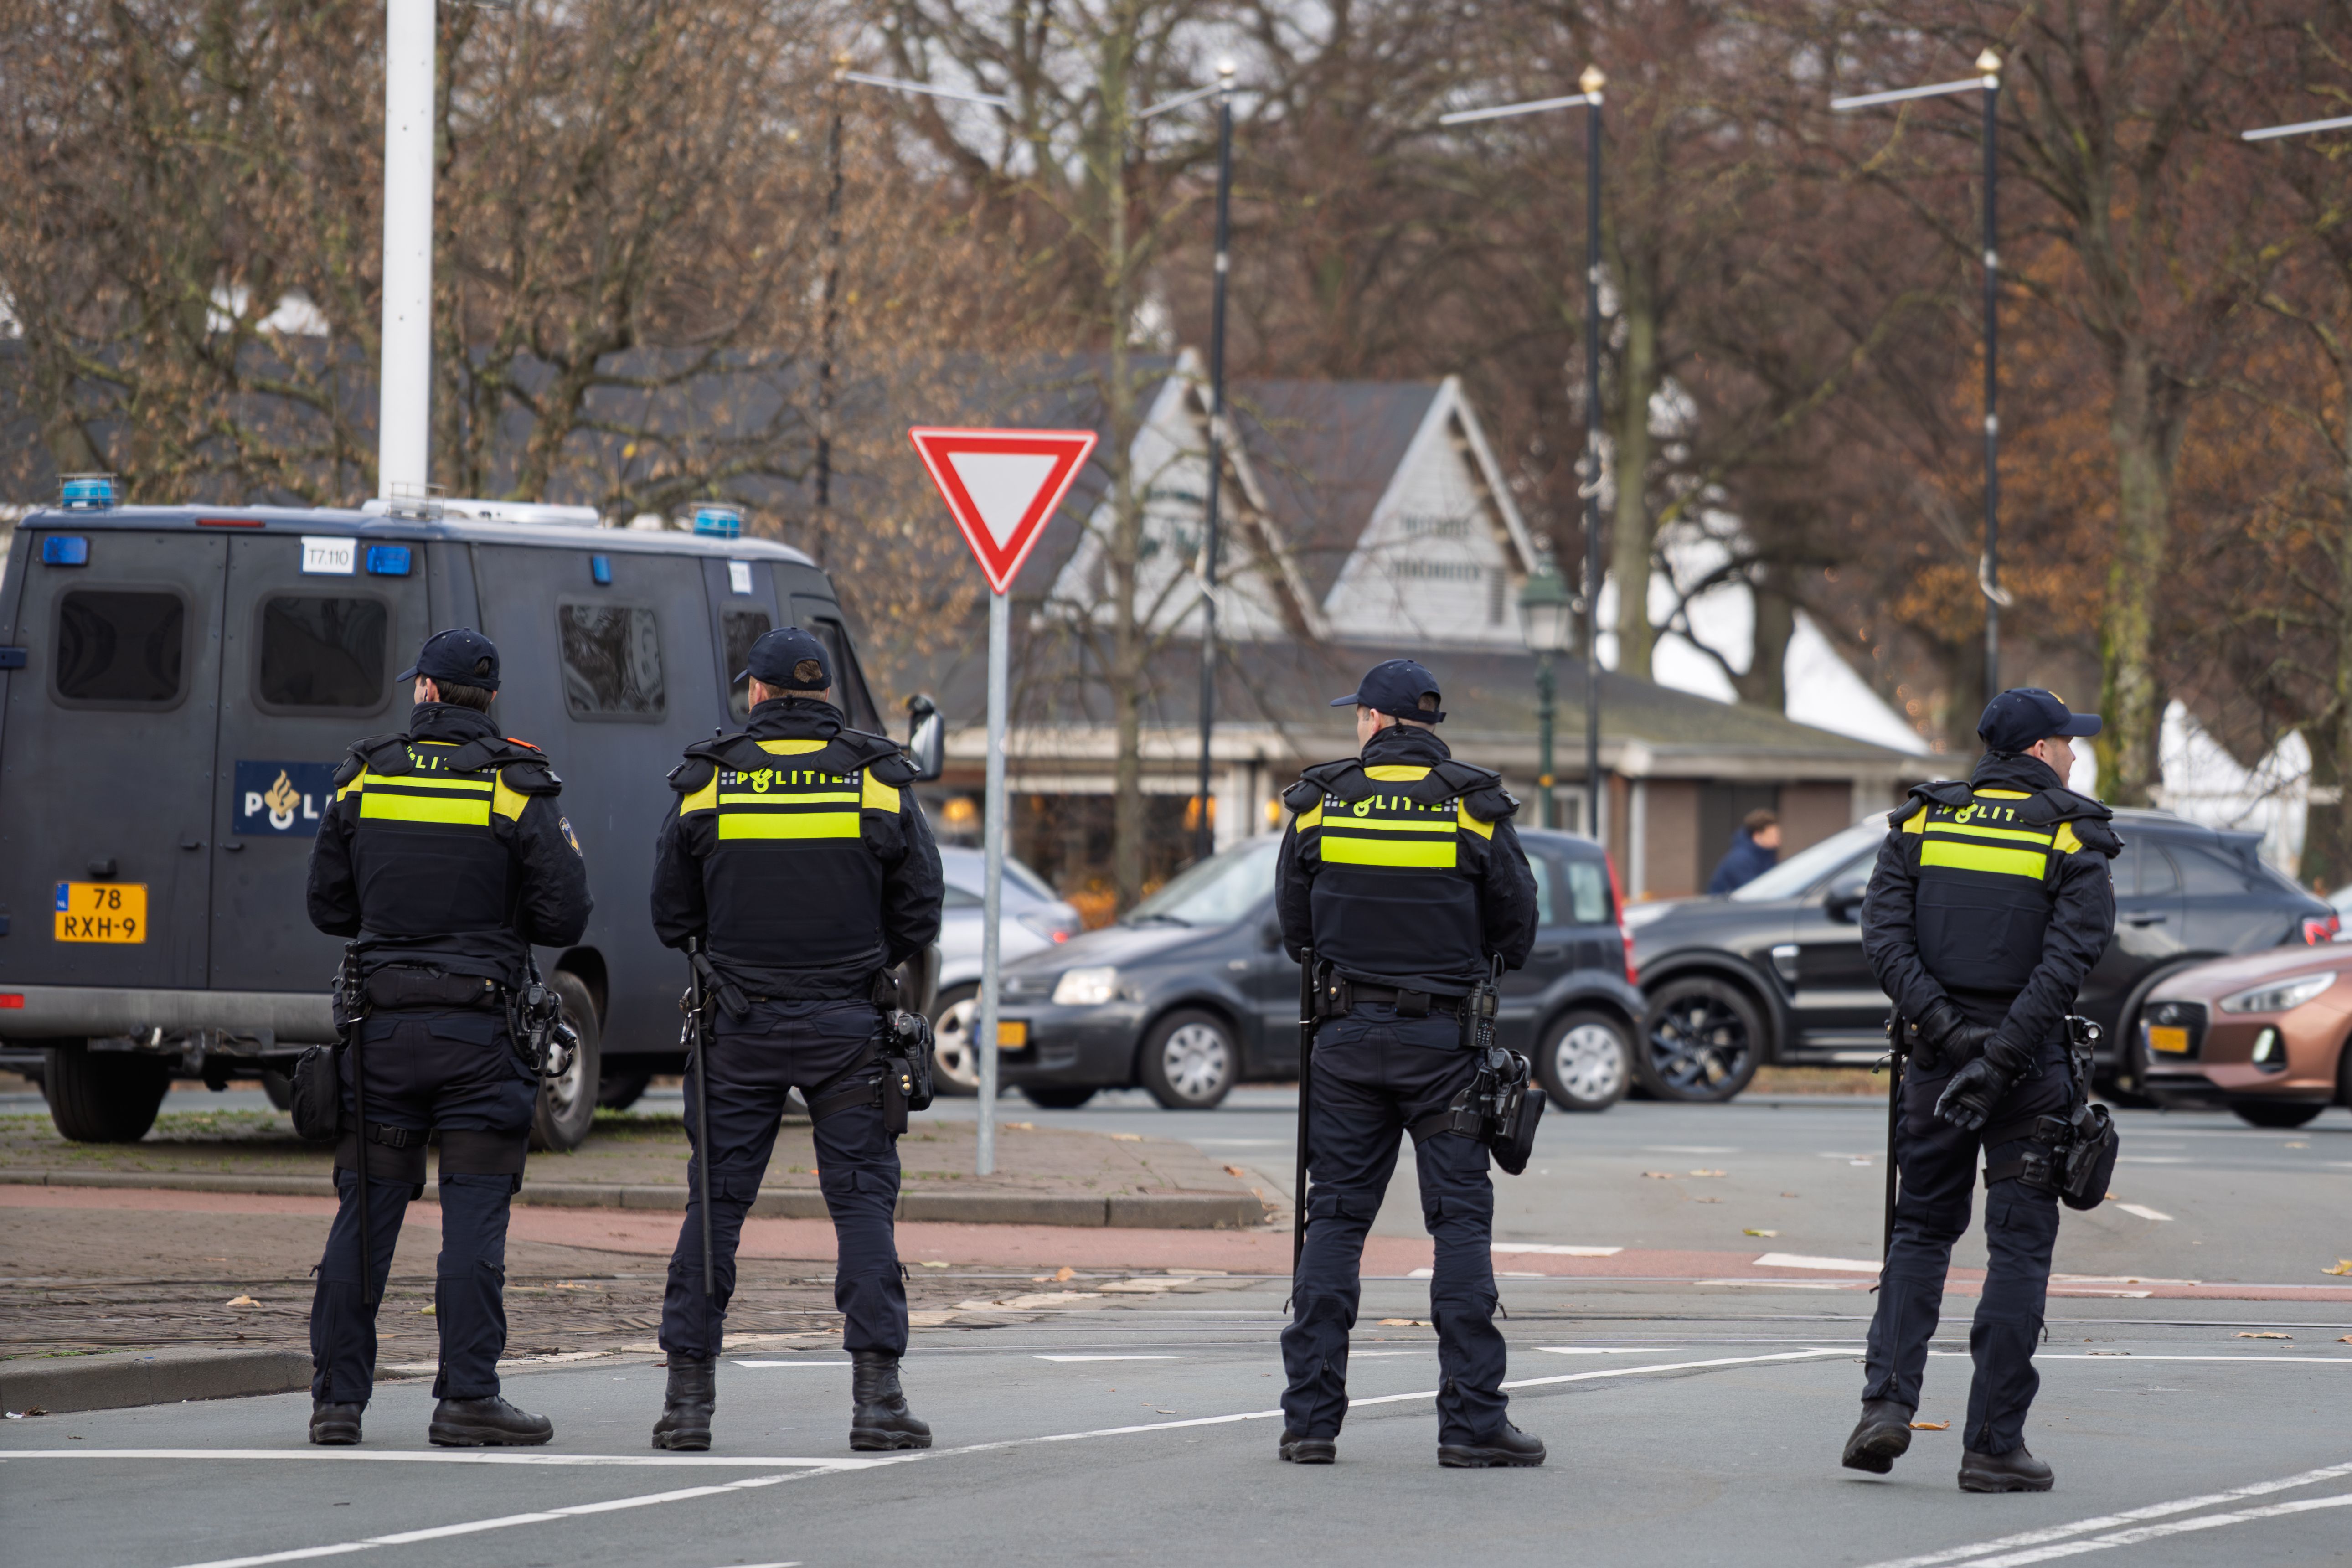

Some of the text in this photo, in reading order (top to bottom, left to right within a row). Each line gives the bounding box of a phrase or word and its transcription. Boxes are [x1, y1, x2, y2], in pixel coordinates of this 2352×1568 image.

[309, 548, 349, 566] T7.110
[57, 900, 67, 908] NL
[93, 888, 121, 910] 78
[64, 916, 136, 939] RXH-9
